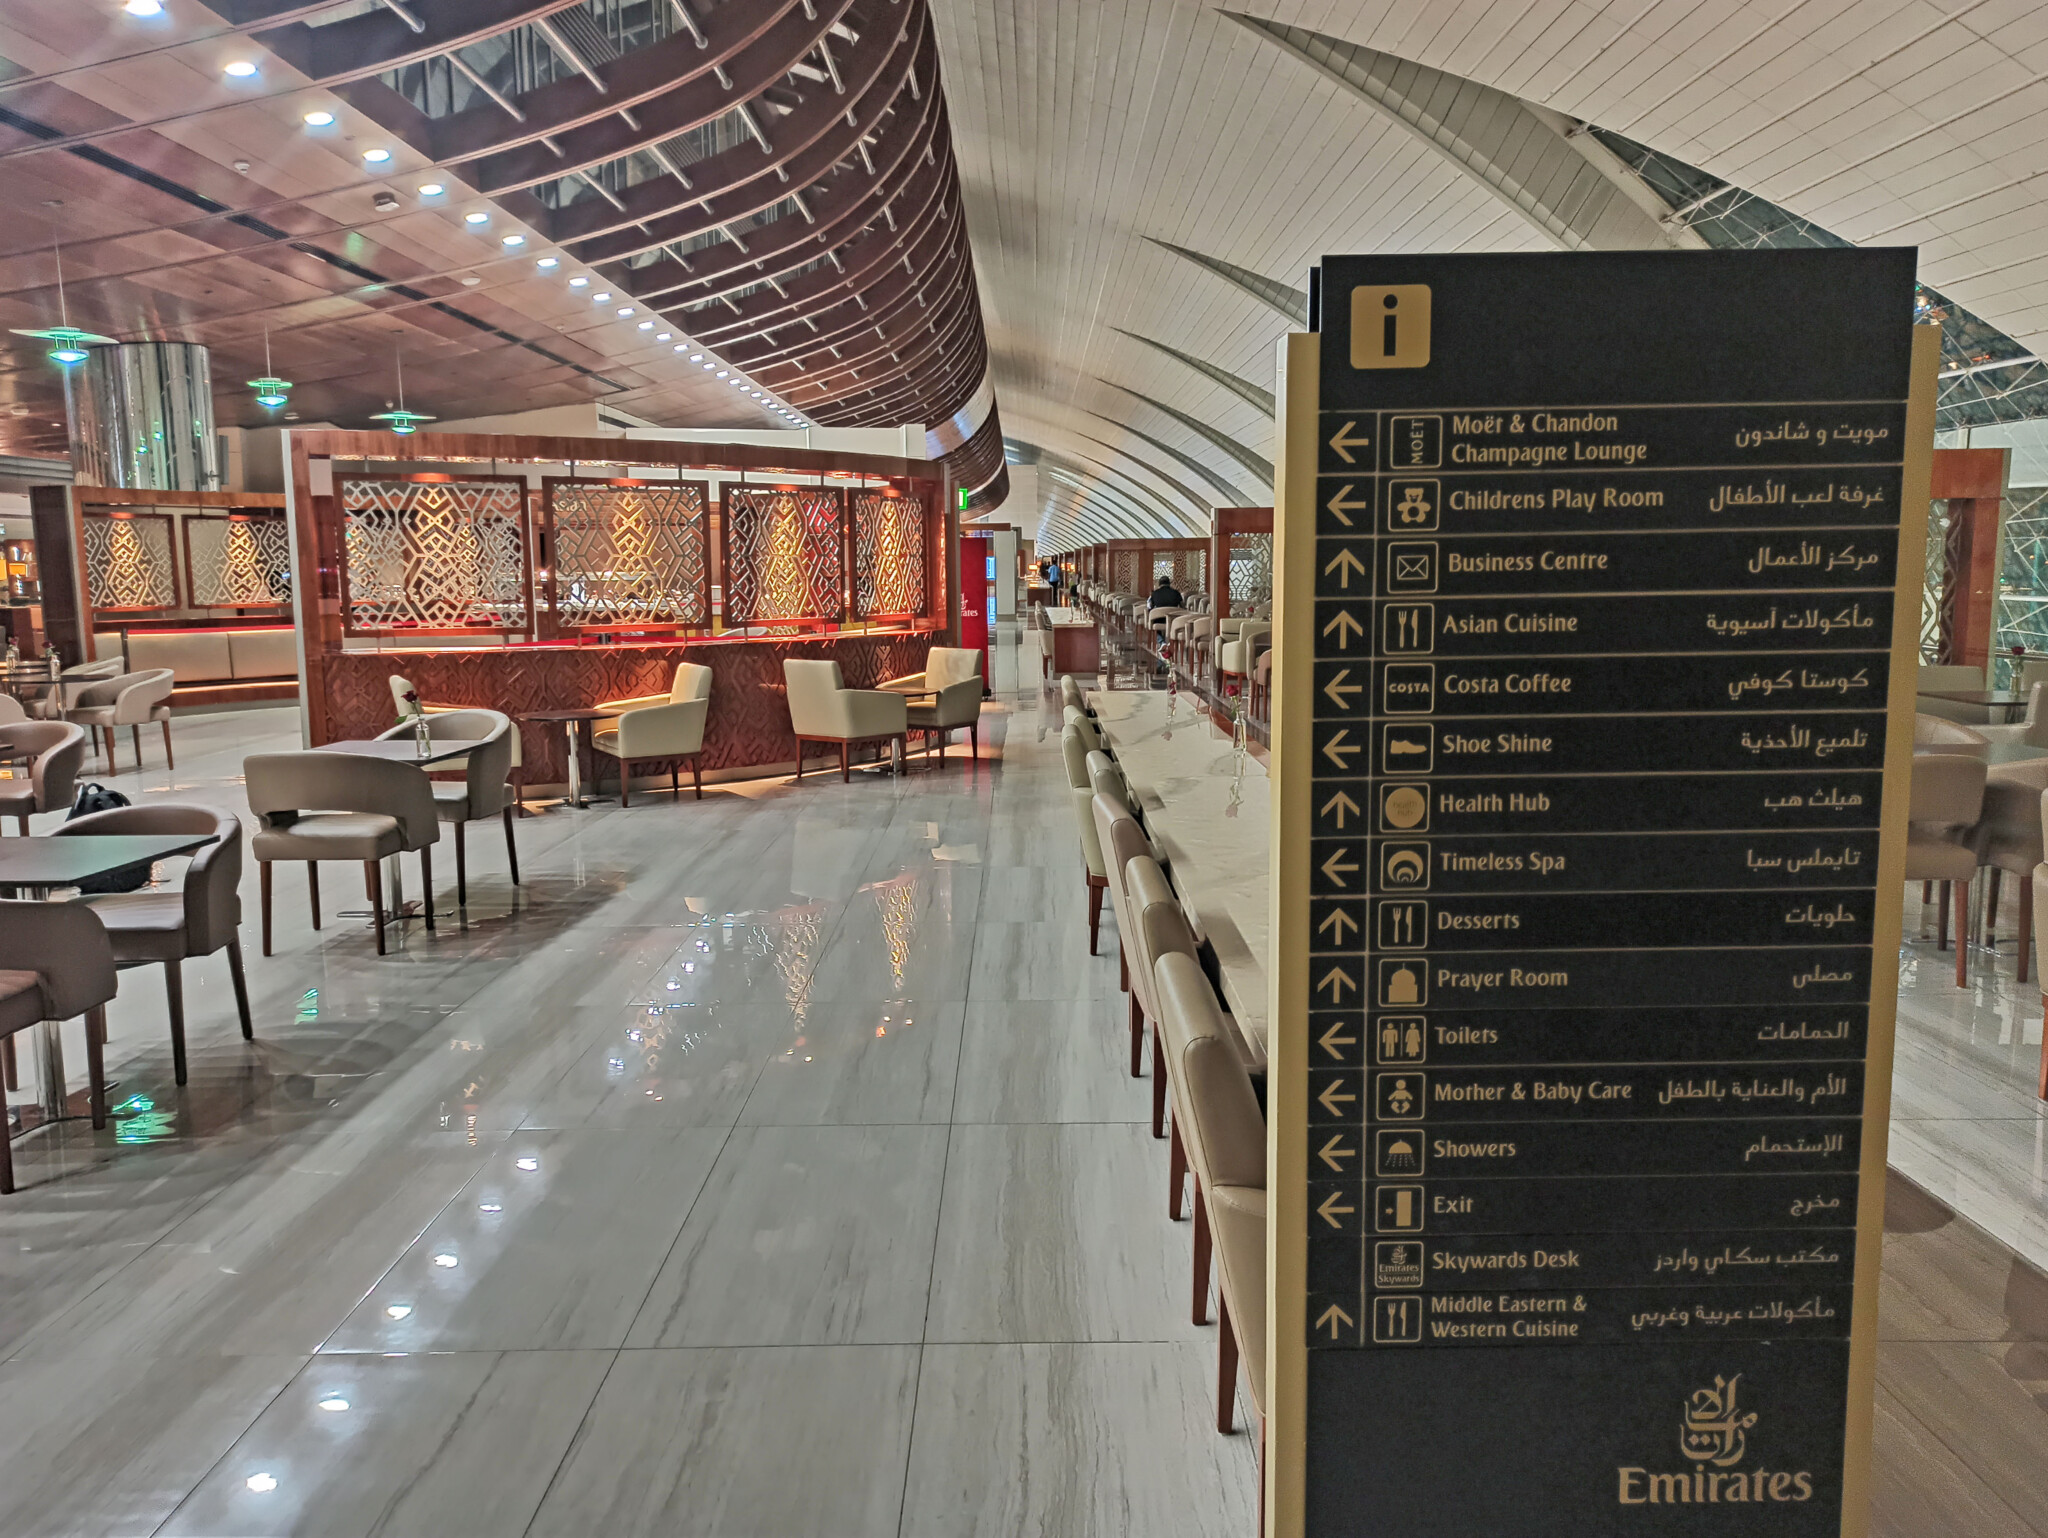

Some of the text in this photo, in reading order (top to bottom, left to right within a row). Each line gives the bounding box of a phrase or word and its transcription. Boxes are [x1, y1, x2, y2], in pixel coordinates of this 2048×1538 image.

[1452, 412, 1618, 435] Moët & Chandon
[1735, 420, 1810, 448] شاندون
[1832, 423, 1889, 445] مويت
[1411, 420, 1424, 464] MOËT
[1451, 440, 1648, 467] Champagne Lounge
[1449, 487, 1664, 513] Childrens Play Room
[1709, 478, 1885, 513] غرفة لعب الأطفال
[1448, 550, 1608, 573] Business Centre
[1747, 541, 1879, 574] مركز الأعمال
[961, 609, 979, 617] rates
[1442, 612, 1578, 634] Asian Cuisine
[1706, 603, 1874, 637] مأكولات آسيوية
[1389, 683, 1430, 694] COSTA
[1443, 673, 1572, 694] Costa Coffee
[1727, 667, 1869, 701] كوستا كوفي
[1442, 733, 1553, 754] Shoe Shine
[1740, 723, 1869, 758] تلميع الأحذية
[1439, 793, 1503, 813] Health
[1509, 792, 1551, 812] Hub
[1763, 787, 1863, 812] هيلث هب
[1439, 851, 1566, 876] Timeless Spa
[1786, 847, 1862, 873] تايملس
[1437, 911, 1520, 930] Desserts
[1784, 903, 1856, 929] حلويات
[1437, 967, 1569, 992] Prayer Room
[1792, 964, 1854, 990] مصلى
[1434, 1026, 1499, 1045] Toilets
[1757, 1020, 1850, 1041] الحمامات
[1434, 1080, 1632, 1105] Mother & Baby Care
[1658, 1079, 1726, 1105] بالطفل
[1731, 1078, 1805, 1103] والعناية
[1433, 1139, 1517, 1158] Showers
[1433, 1195, 1474, 1214] Exit
[1789, 1194, 1841, 1220] مخرج
[1379, 1264, 1420, 1272] Emirates
[1432, 1250, 1528, 1274] Skywards
[1533, 1249, 1580, 1268] Desk
[1653, 1245, 1840, 1275] مكتب سكاي واردز
[1378, 1274, 1420, 1285] Skywards
[1431, 1294, 1588, 1313] Middle Eastern &
[1630, 1295, 1836, 1332] مأكولات عربية وغربي
[1430, 1319, 1579, 1338] Western Cuisine
[1617, 1463, 1813, 1505] Emirates
